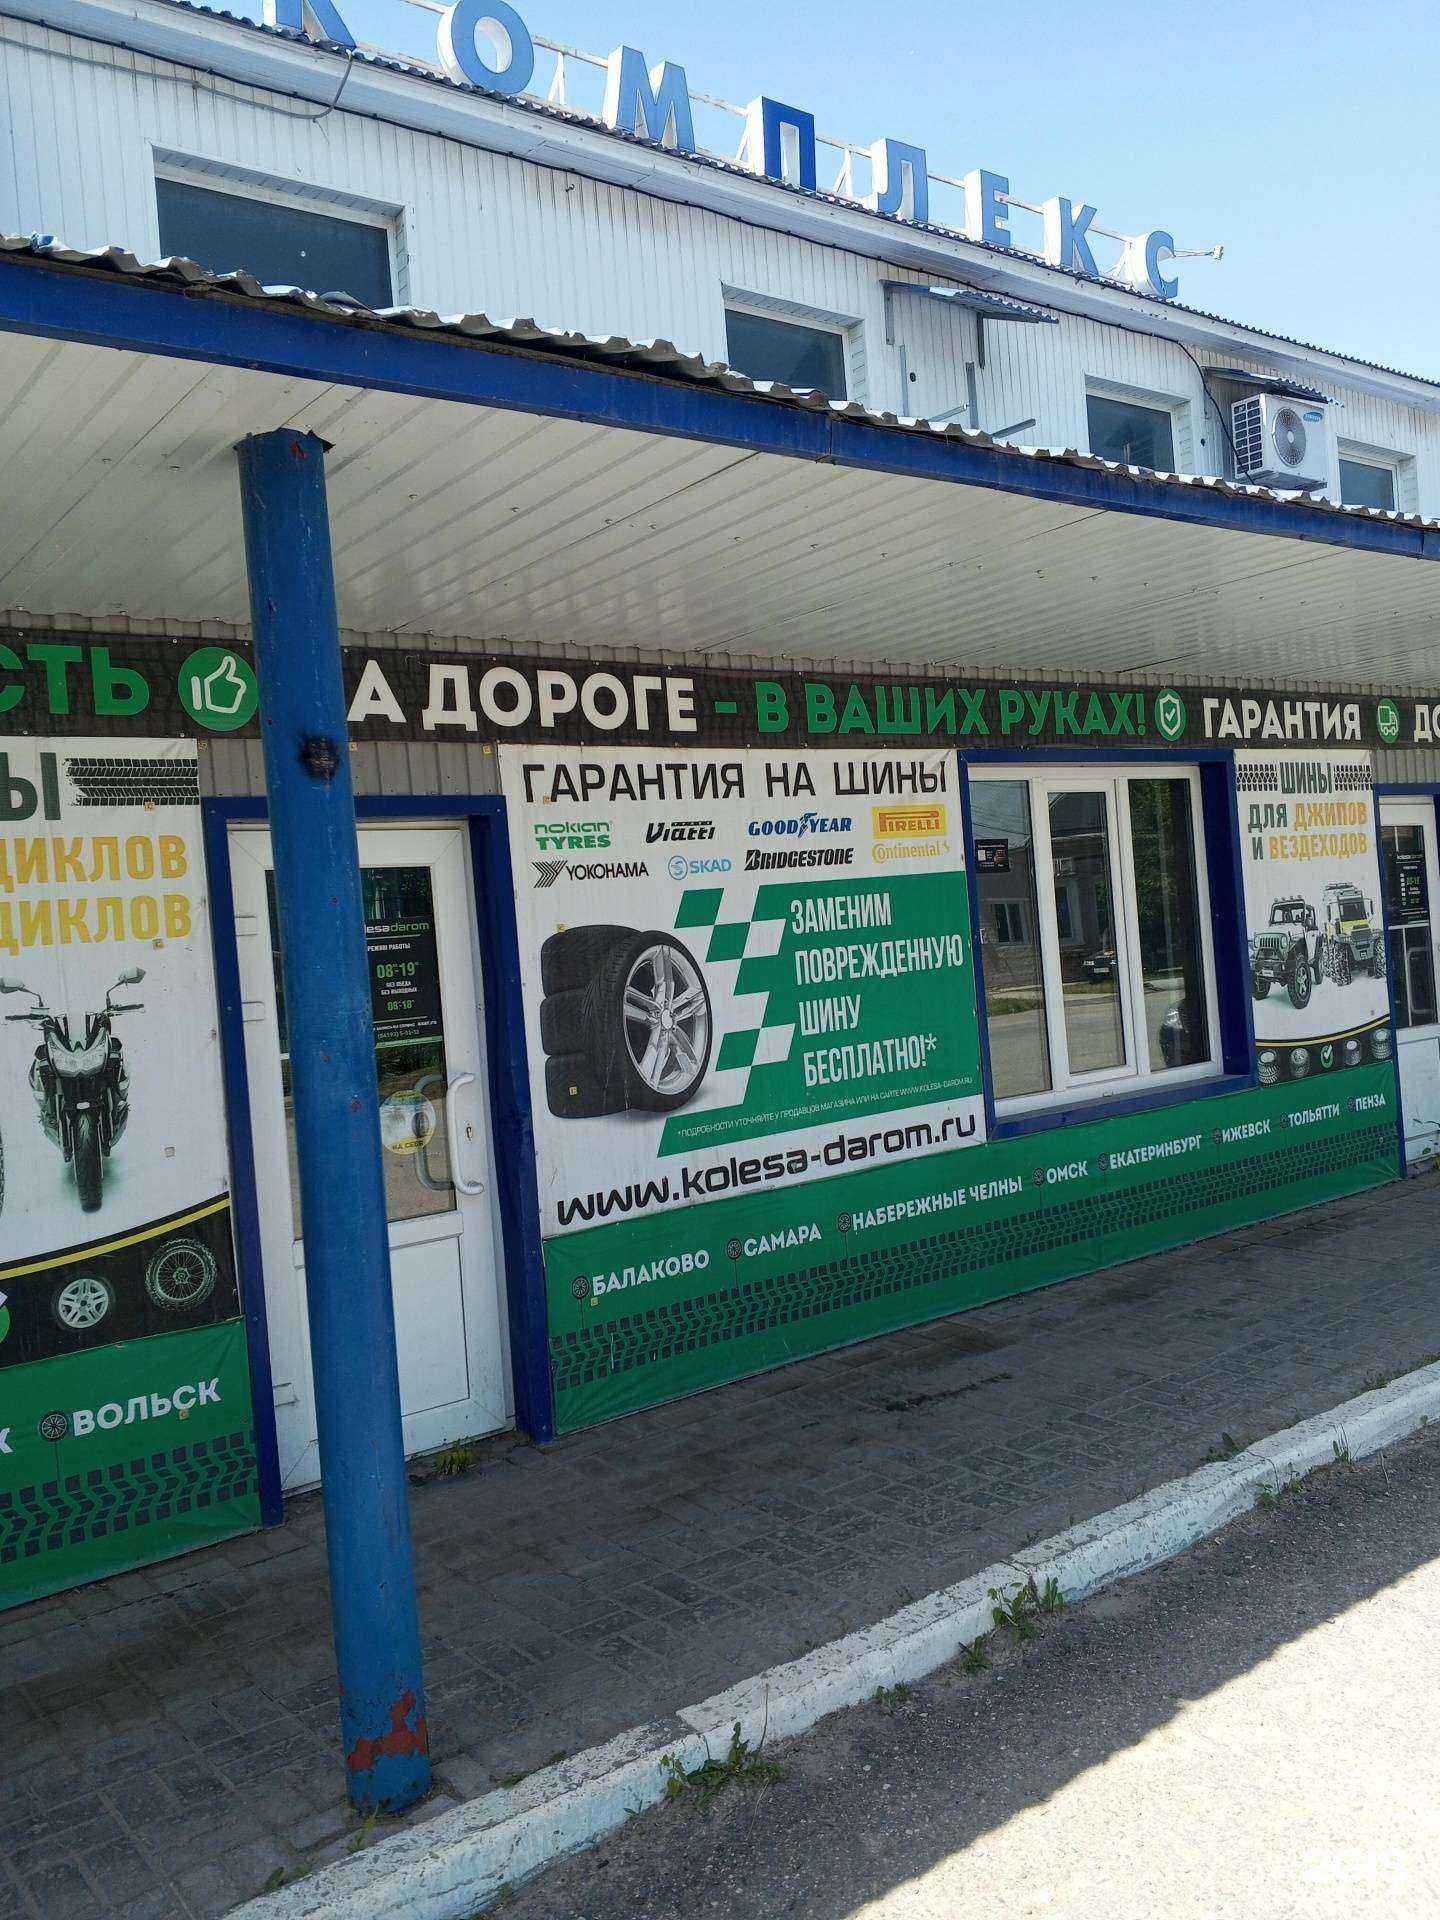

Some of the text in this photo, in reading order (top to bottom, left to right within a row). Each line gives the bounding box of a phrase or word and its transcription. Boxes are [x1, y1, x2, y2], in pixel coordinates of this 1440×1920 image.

[422, 664, 697, 731] ДОРОГЕ
[755, 682, 789, 733] В
[805, 683, 990, 735] ВАШИХ
[999, 690, 1146, 736] РУКАХ!
[1203, 697, 1361, 740] ГАРАНТИЯ
[522, 760, 946, 803] ГАРАНТИЯ НА ШИНЫ
[1280, 762, 1332, 794] ШИНЫ
[646, 821, 716, 844] Viatti
[879, 810, 940, 832] PIRELLI
[1248, 801, 1368, 833] ДЛЯ ДЖИПОВ
[536, 834, 611, 850] TYRES
[872, 841, 942, 864] Continental
[1252, 832, 1368, 861] И ВЕЗДЕХОДОВ
[0, 835, 188, 893] ИКЛОВ
[566, 861, 649, 881] YOKOHAMA
[690, 858, 731, 874] SKAD
[744, 848, 853, 871] BRIDGESTONE
[790, 893, 892, 935] ЗАМЕНИМ
[795, 935, 964, 985] ПОВРЕЖДЕННУЮ
[799, 994, 861, 1036] ШИНУ
[1288, 1103, 1340, 1128] ТОЛЬЯТТИ
[1355, 1093, 1386, 1112] ПЕНЗА
[1222, 1119, 1270, 1145] ИЖЕВСК
[1109, 1135, 1202, 1170] ЕКАТЕРИНБУРГ
[557, 1114, 976, 1226] www.kolesa-darom.ru
[1046, 1160, 1088, 1185] ОМСК
[852, 1174, 1023, 1231] НАБЕРЕЖНЫЕ ЧЕЛНЫ
[743, 1223, 822, 1258] САМАРА
[593, 1250, 710, 1296] БАЛАКОВО
[73, 1377, 221, 1436] ВОЛЬСК
